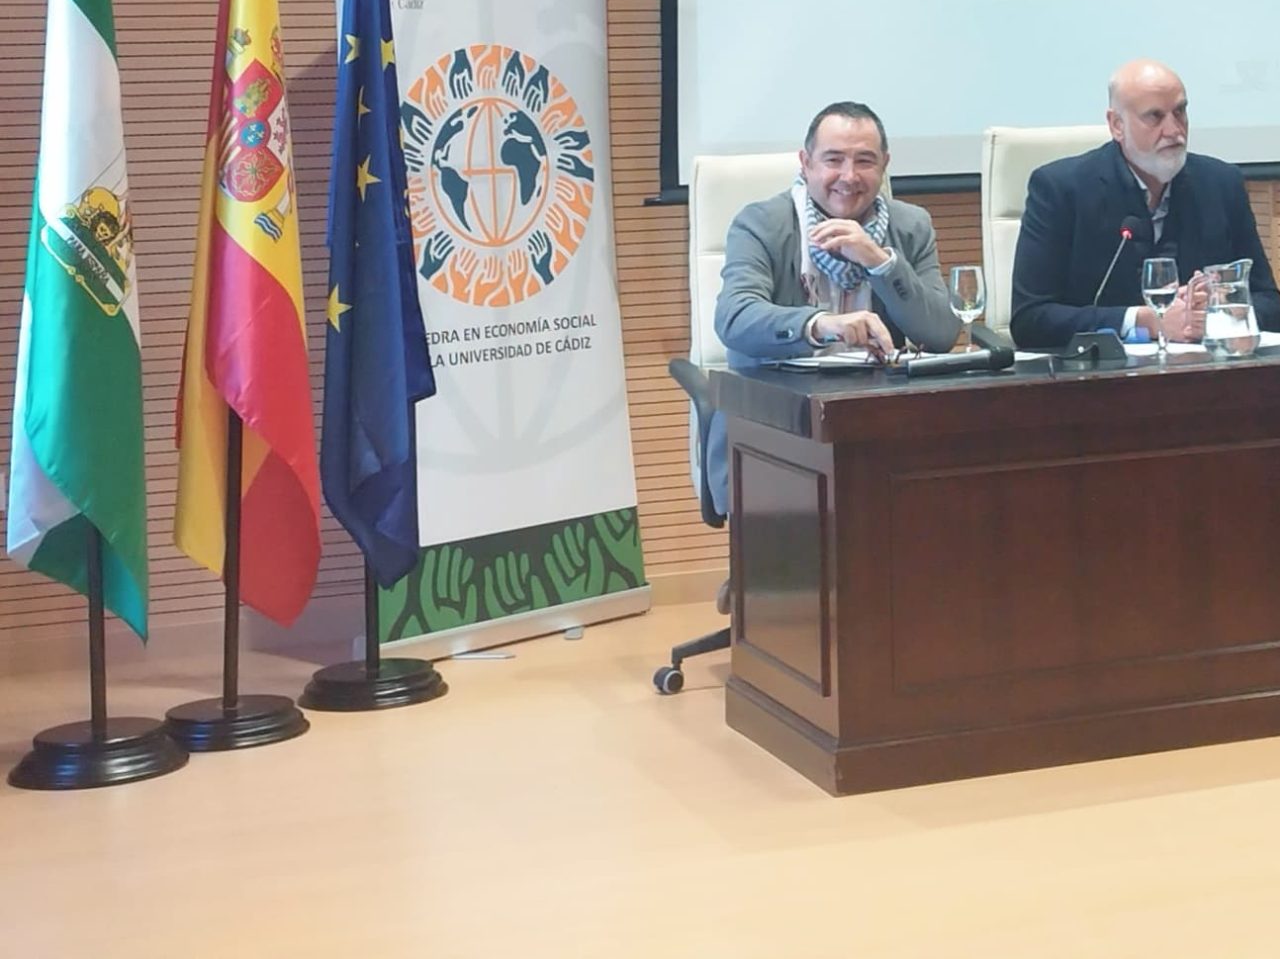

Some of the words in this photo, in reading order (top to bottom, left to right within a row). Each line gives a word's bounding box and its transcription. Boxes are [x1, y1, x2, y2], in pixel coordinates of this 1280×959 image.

[463, 327, 480, 342] EN
[484, 316, 551, 340] ECONOMÍA
[553, 313, 598, 332] SOCIAL
[448, 343, 533, 367] UNIVERSIDAD
[535, 339, 553, 356] DE
[554, 334, 593, 353] CÁDIZ
